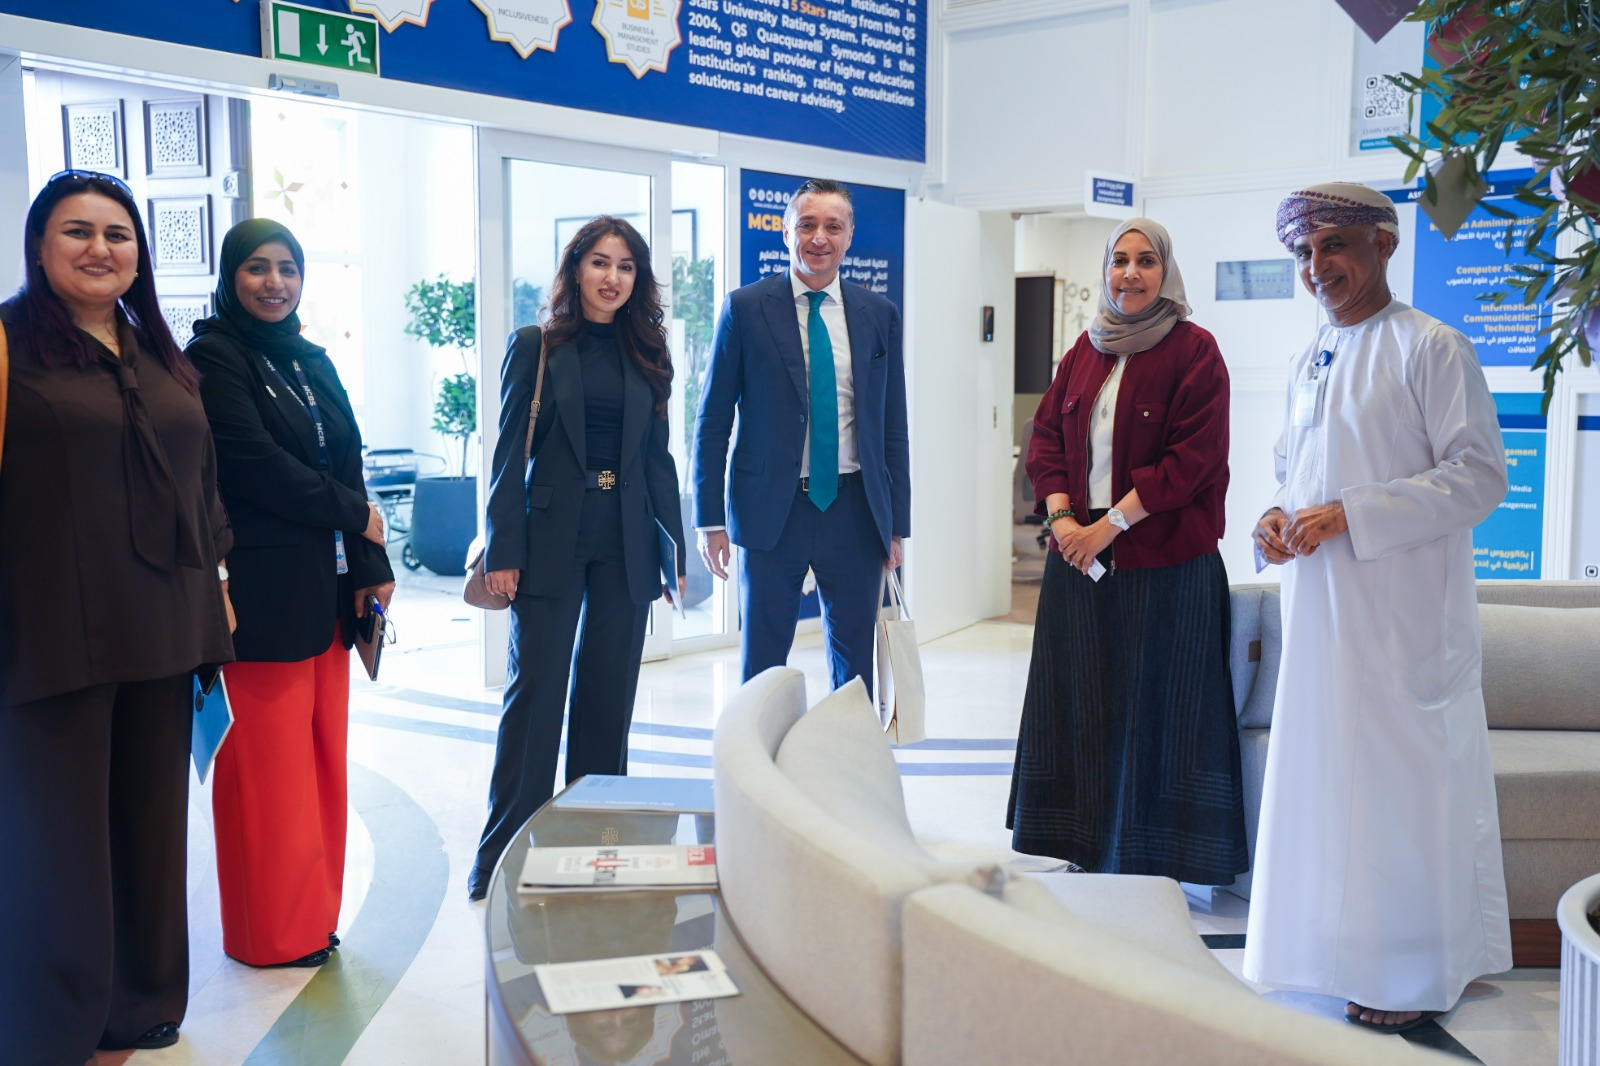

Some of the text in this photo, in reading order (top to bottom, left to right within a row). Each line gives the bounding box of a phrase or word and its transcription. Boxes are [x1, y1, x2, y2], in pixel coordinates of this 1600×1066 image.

[498, 8, 549, 25] INCLUSIVENESS
[791, 0, 798, 11] 5
[800, 1, 826, 18] Stars
[827, 9, 857, 28] rating
[859, 14, 883, 32] from
[884, 21, 900, 36] the
[902, 26, 916, 41] QS
[906, 9, 916, 23] in
[622, 22, 649, 36] BUSINESS
[723, 1, 778, 28] University
[782, 14, 816, 37] Rating
[819, 23, 858, 44] System.
[861, 33, 903, 54] Founded
[906, 42, 916, 57] in
[618, 32, 658, 46] MANAGEMENT
[688, 12, 915, 73] 2004, QS Quacquarelli Symonds is the
[626, 43, 651, 55] STUDIES
[689, 30, 915, 90] leading global provider of higher education
[689, 49, 915, 107] institution's ranking, rating, consultations
[689, 71, 845, 113] solutions and career advising.
[748, 212, 784, 232] MCB
[1456, 265, 1502, 276] Computer
[1481, 302, 1537, 312] Information
[1463, 313, 1537, 323] Communication
[1484, 324, 1536, 333] Technology
[302, 385, 316, 407] MCBS
[316, 422, 326, 448] MCBS
[1510, 484, 1532, 493] Media
[1498, 502, 1537, 511] anagement
